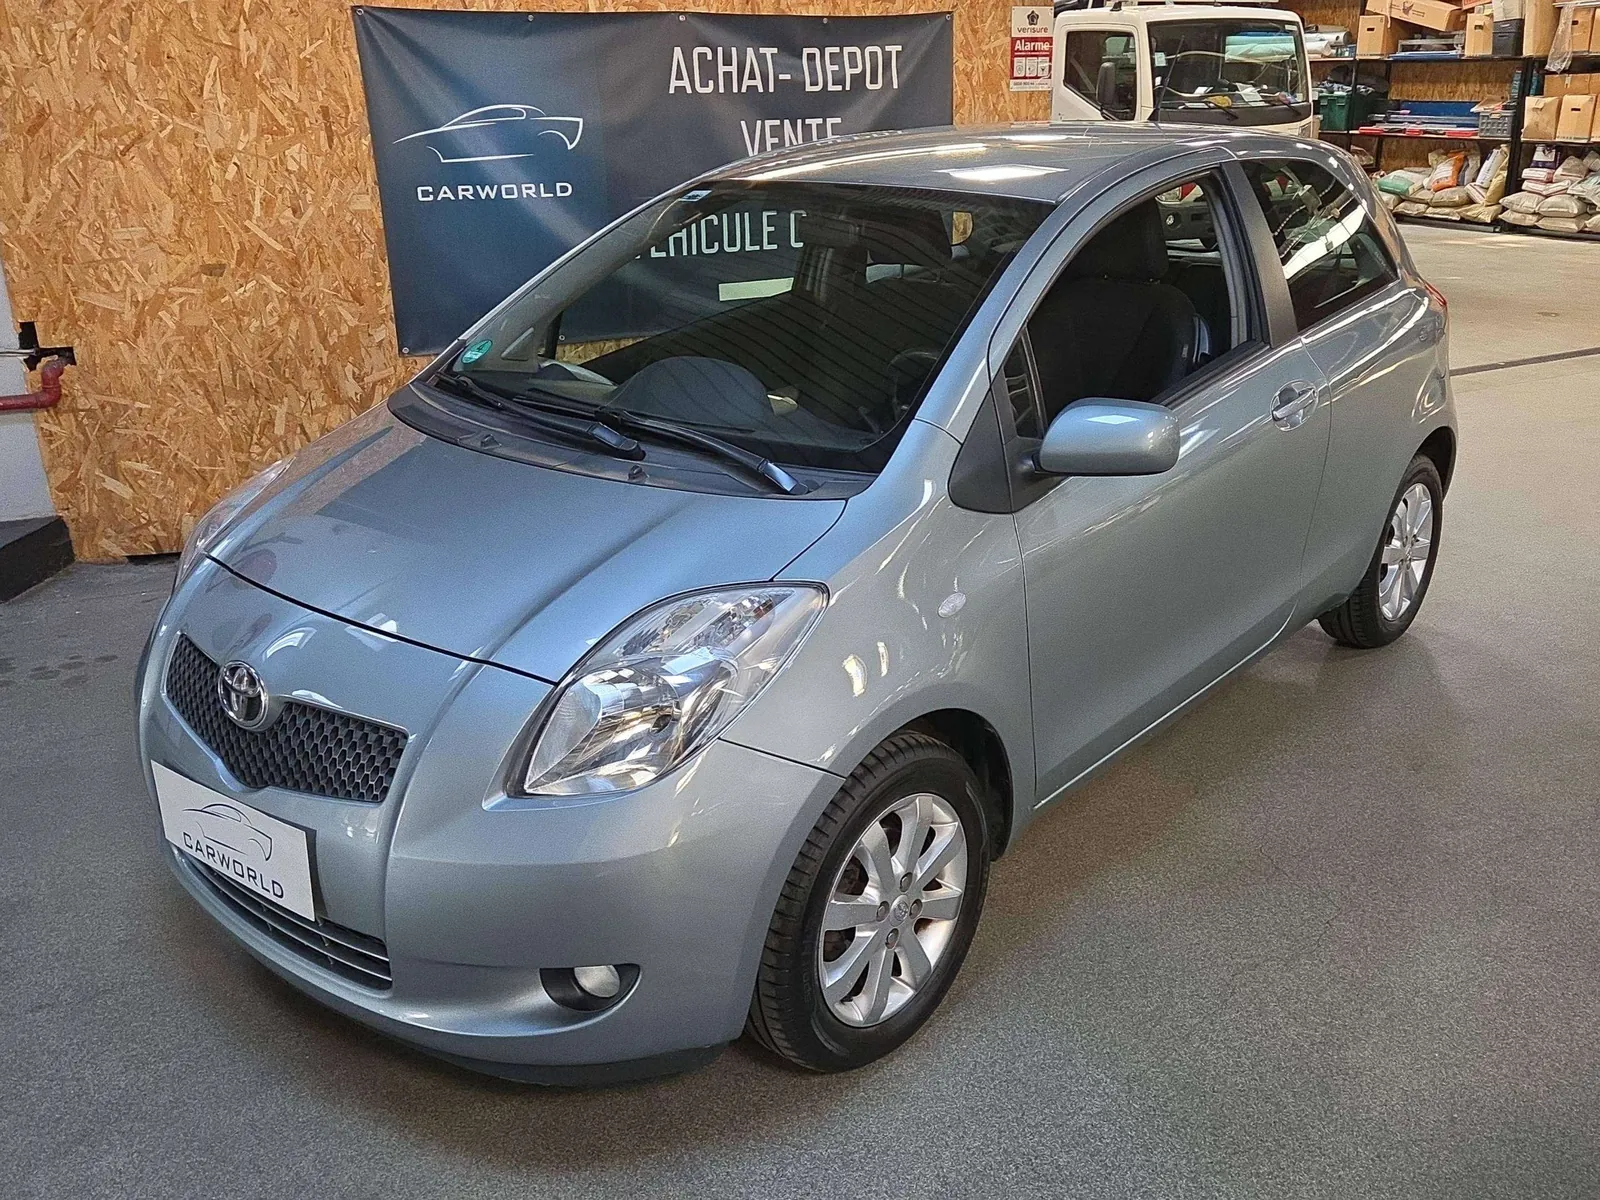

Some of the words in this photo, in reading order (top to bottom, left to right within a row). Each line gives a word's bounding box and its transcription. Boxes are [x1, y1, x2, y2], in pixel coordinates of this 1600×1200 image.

[668, 46, 791, 94] ACHAT-
[802, 45, 902, 92] DEPOT
[1014, 39, 1050, 51] Alarme
[416, 182, 573, 201] CARWORLD
[635, 210, 778, 260] HICULE
[182, 831, 284, 899] CARWORLD
